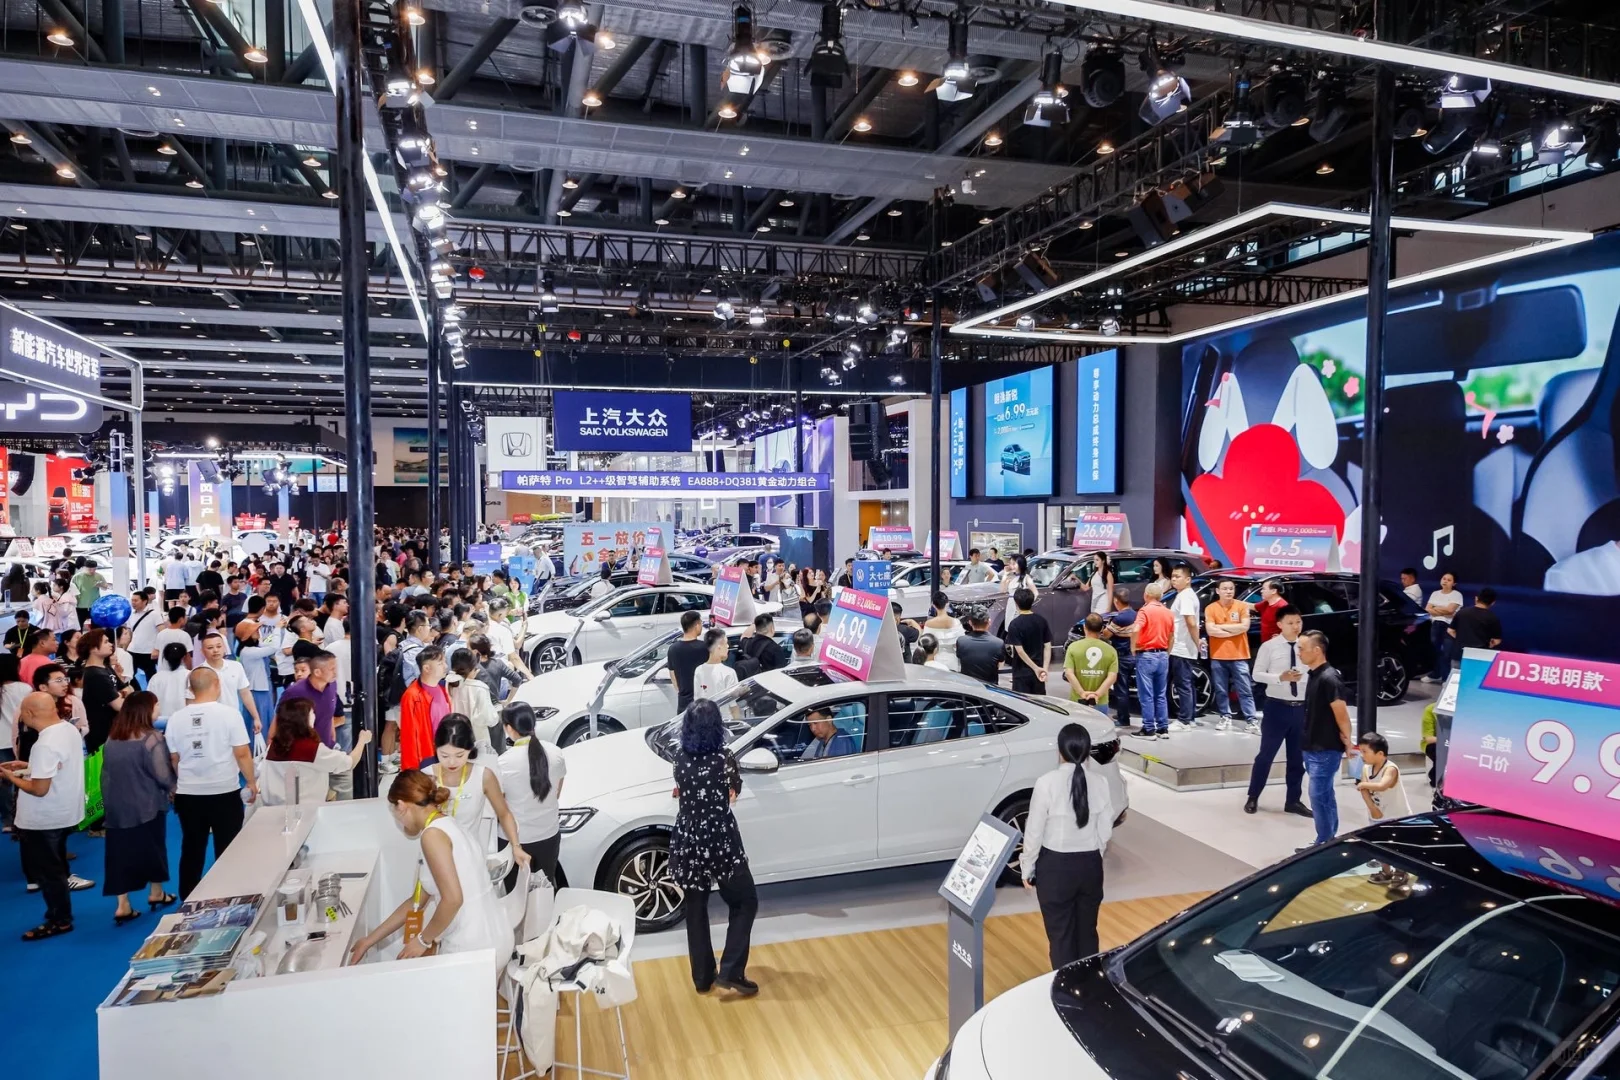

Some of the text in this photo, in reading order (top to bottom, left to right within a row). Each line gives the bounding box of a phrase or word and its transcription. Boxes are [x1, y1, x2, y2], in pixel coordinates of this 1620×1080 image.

[10, 327, 99, 380] 新能源汽车世界冠军
[0, 393, 88, 421] YD
[579, 407, 668, 427] 上汽大众
[580, 427, 668, 437] SAIC VOLKSWAGEN
[517, 474, 551, 486] 帕萨特
[555, 475, 573, 485] Pro
[581, 531, 646, 546] 五一放价
[1083, 524, 1114, 538] 26.99
[1269, 538, 1302, 557] 6.5
[869, 571, 891, 581] 大七座
[836, 613, 867, 649] 6.99
[1085, 646, 1103, 669] 9
[1497, 660, 1605, 692] ID.3聪明款
[1480, 734, 1513, 753] 金融
[1463, 754, 1511, 773] 一口价
